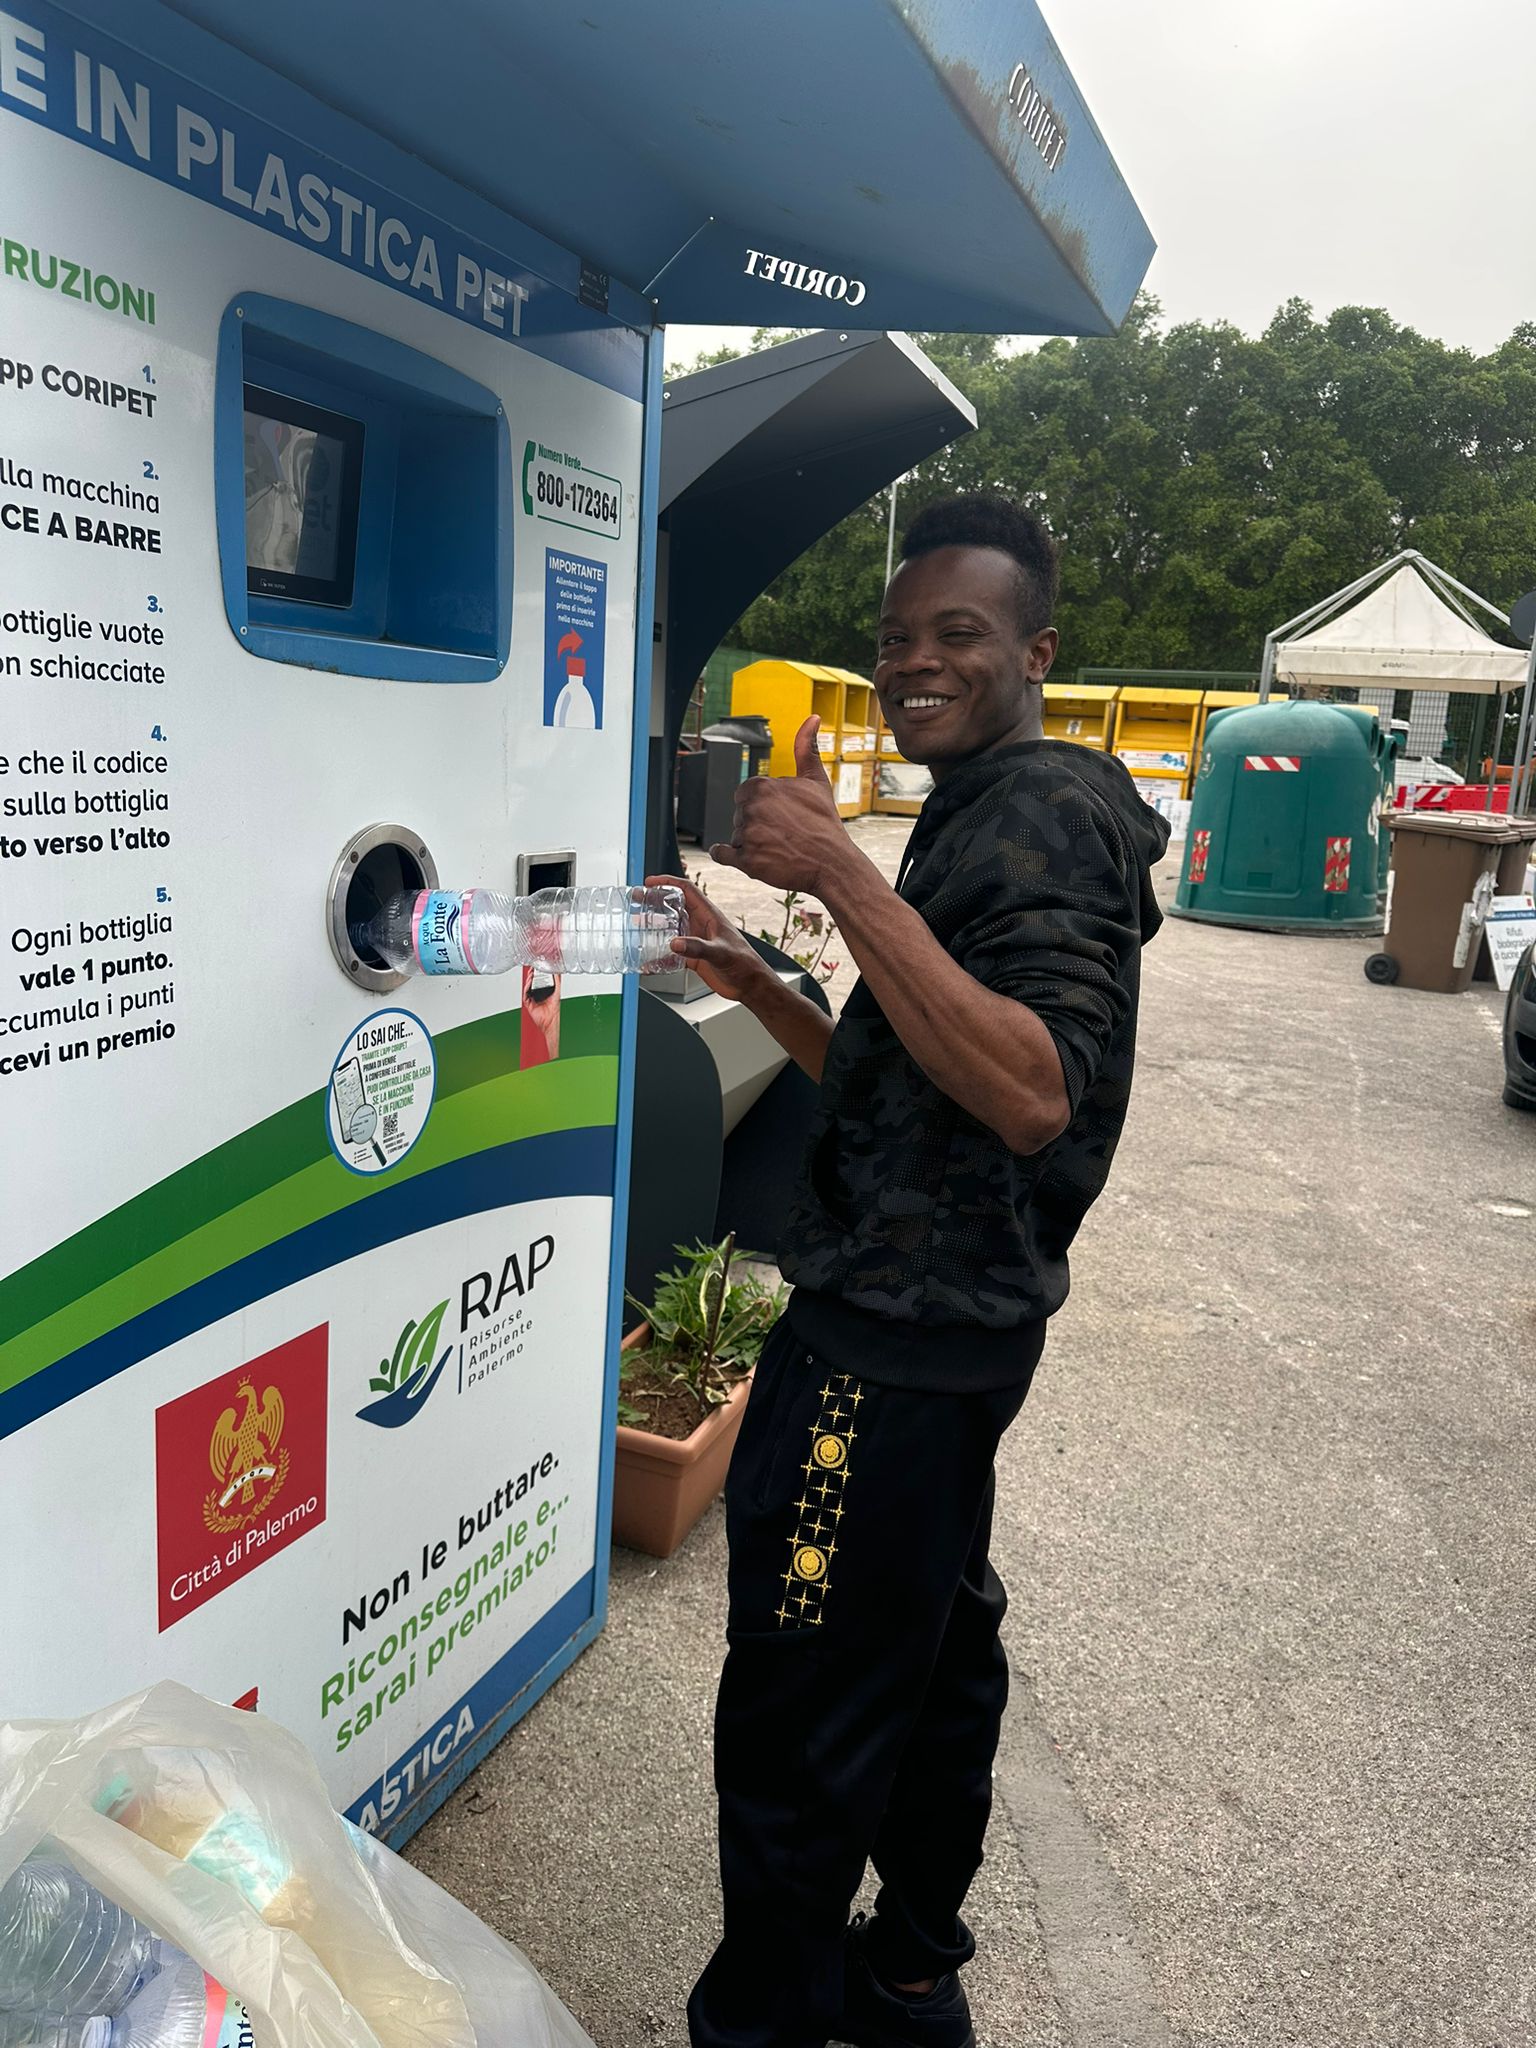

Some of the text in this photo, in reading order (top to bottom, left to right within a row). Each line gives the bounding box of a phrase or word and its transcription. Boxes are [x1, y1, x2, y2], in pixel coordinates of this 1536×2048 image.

[1009, 62, 1066, 172] CORIPET
[74, 50, 151, 161] IN
[176, 104, 444, 306] PLASTICA
[456, 253, 530, 337] PET
[0, 237, 156, 325] RUZIONI
[41, 364, 158, 418] CORIPET
[142, 364, 157, 385] 1.
[143, 461, 159, 480] 2.
[538, 444, 581, 470] Numero Verde
[42, 472, 160, 513] macchina
[537, 471, 618, 524] 800-172364
[1, 503, 162, 554] CE A BARRE
[549, 556, 605, 582] IMPORTANTE!
[147, 595, 164, 613] 3.
[0, 610, 164, 646] ottiglie vuote
[30, 653, 166, 684] schiacciate
[151, 725, 168, 742] 4.
[18, 750, 64, 774] che
[72, 750, 87, 774] il
[94, 750, 169, 774] codice
[3, 788, 169, 818] sulla bottiglia
[34, 834, 104, 856] verso
[110, 827, 171, 851] l'alto
[156, 887, 173, 903] 5.
[11, 912, 172, 956] Ogni bottiglia
[430, 902, 448, 943] Fonte
[19, 951, 173, 992] vale 1 punto.
[434, 946, 451, 965] La
[107, 993, 113, 1015] i
[120, 982, 174, 1018] punti
[0, 1019, 177, 1075] cevi un premio
[357, 1021, 414, 1051] LO SAI CHE...
[419, 1065, 431, 1076] CASA
[372, 1083, 414, 1105] SE LA MACCHINA
[389, 1094, 414, 1112] FUNZIONE
[460, 1235, 555, 1333] RAP
[469, 1320, 533, 1368] Ambiente
[470, 1309, 523, 1349] Risorse
[170, 1496, 318, 1601] Città di Palermo
[343, 1451, 559, 1646] Non le buttare.
[321, 1495, 569, 1719] Riconsegnale e...
[336, 1525, 558, 1754] sarai premiato!
